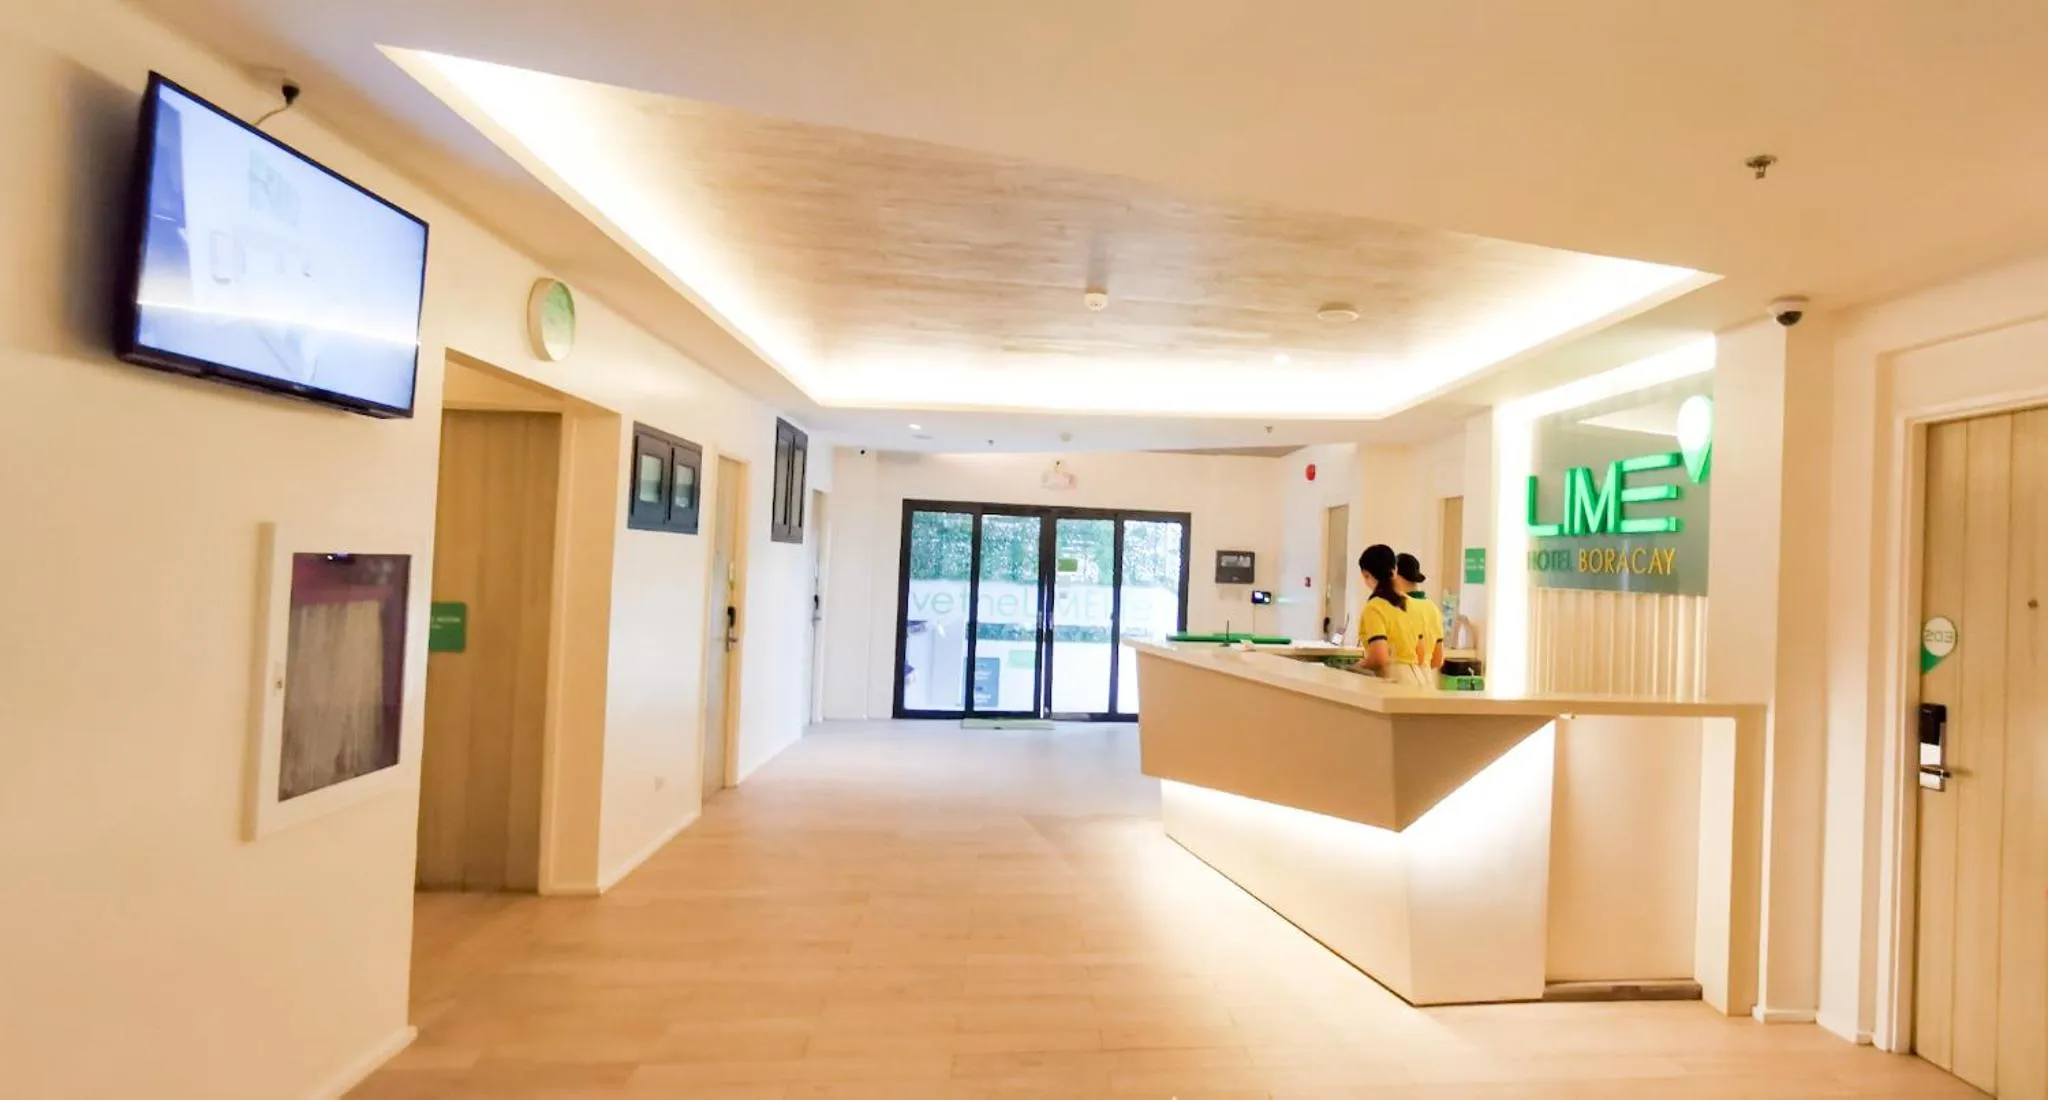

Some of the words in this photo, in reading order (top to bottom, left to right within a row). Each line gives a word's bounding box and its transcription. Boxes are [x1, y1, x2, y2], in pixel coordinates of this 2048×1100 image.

[1526, 452, 1683, 537] LIME
[1527, 548, 1572, 571] HOTEL
[1578, 547, 1676, 576] BORACAY
[1924, 629, 1953, 644] 203
